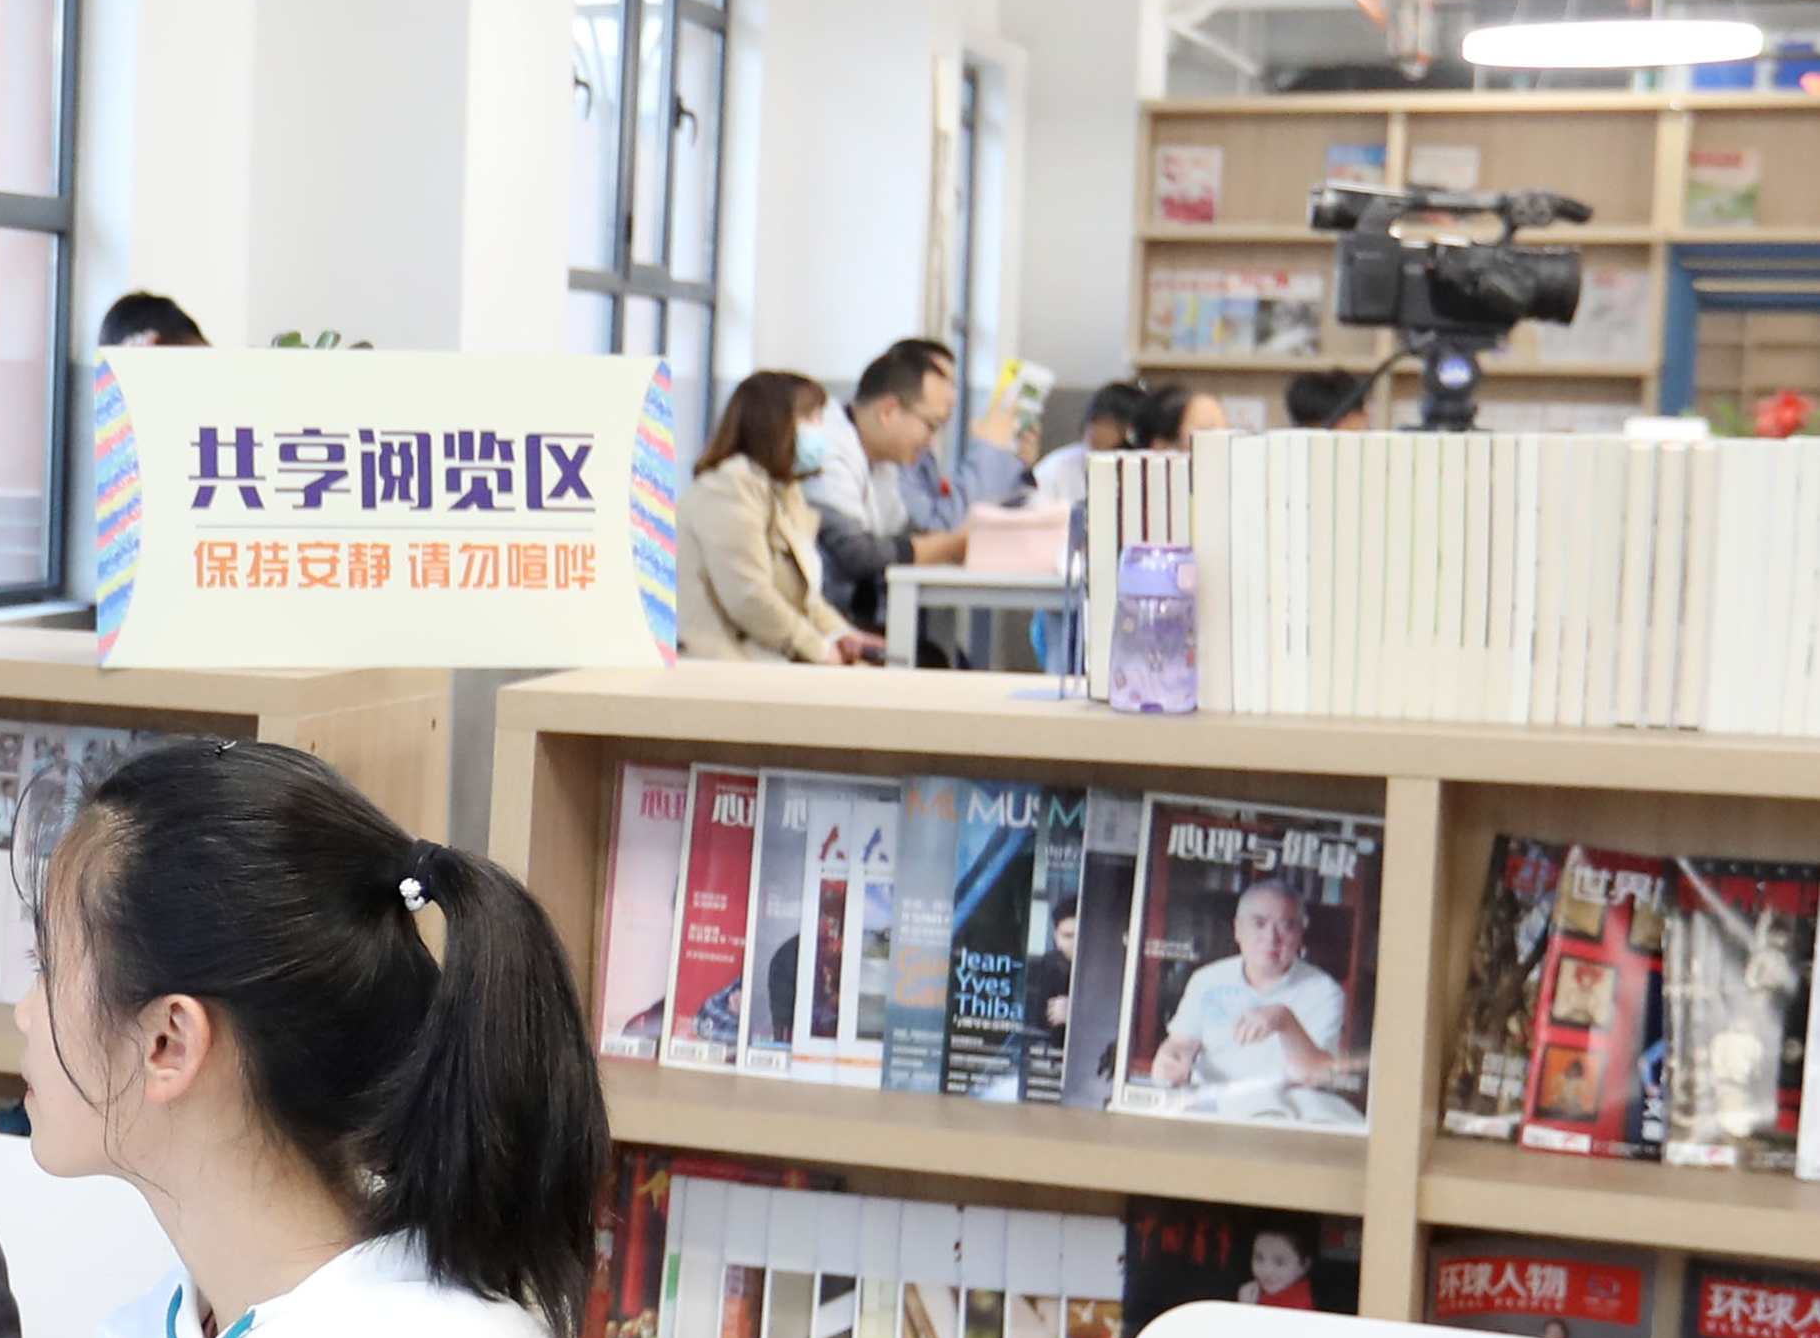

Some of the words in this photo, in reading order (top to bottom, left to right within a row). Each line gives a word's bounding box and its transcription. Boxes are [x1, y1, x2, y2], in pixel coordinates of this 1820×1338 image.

[188, 426, 597, 513] 共享阅览区
[193, 540, 392, 590] 保持安静
[408, 542, 597, 590] 请勿喧哗
[1571, 861, 1666, 912] 世界
[954, 966, 1013, 998] Yves
[1436, 1260, 1568, 1299] 环球人物
